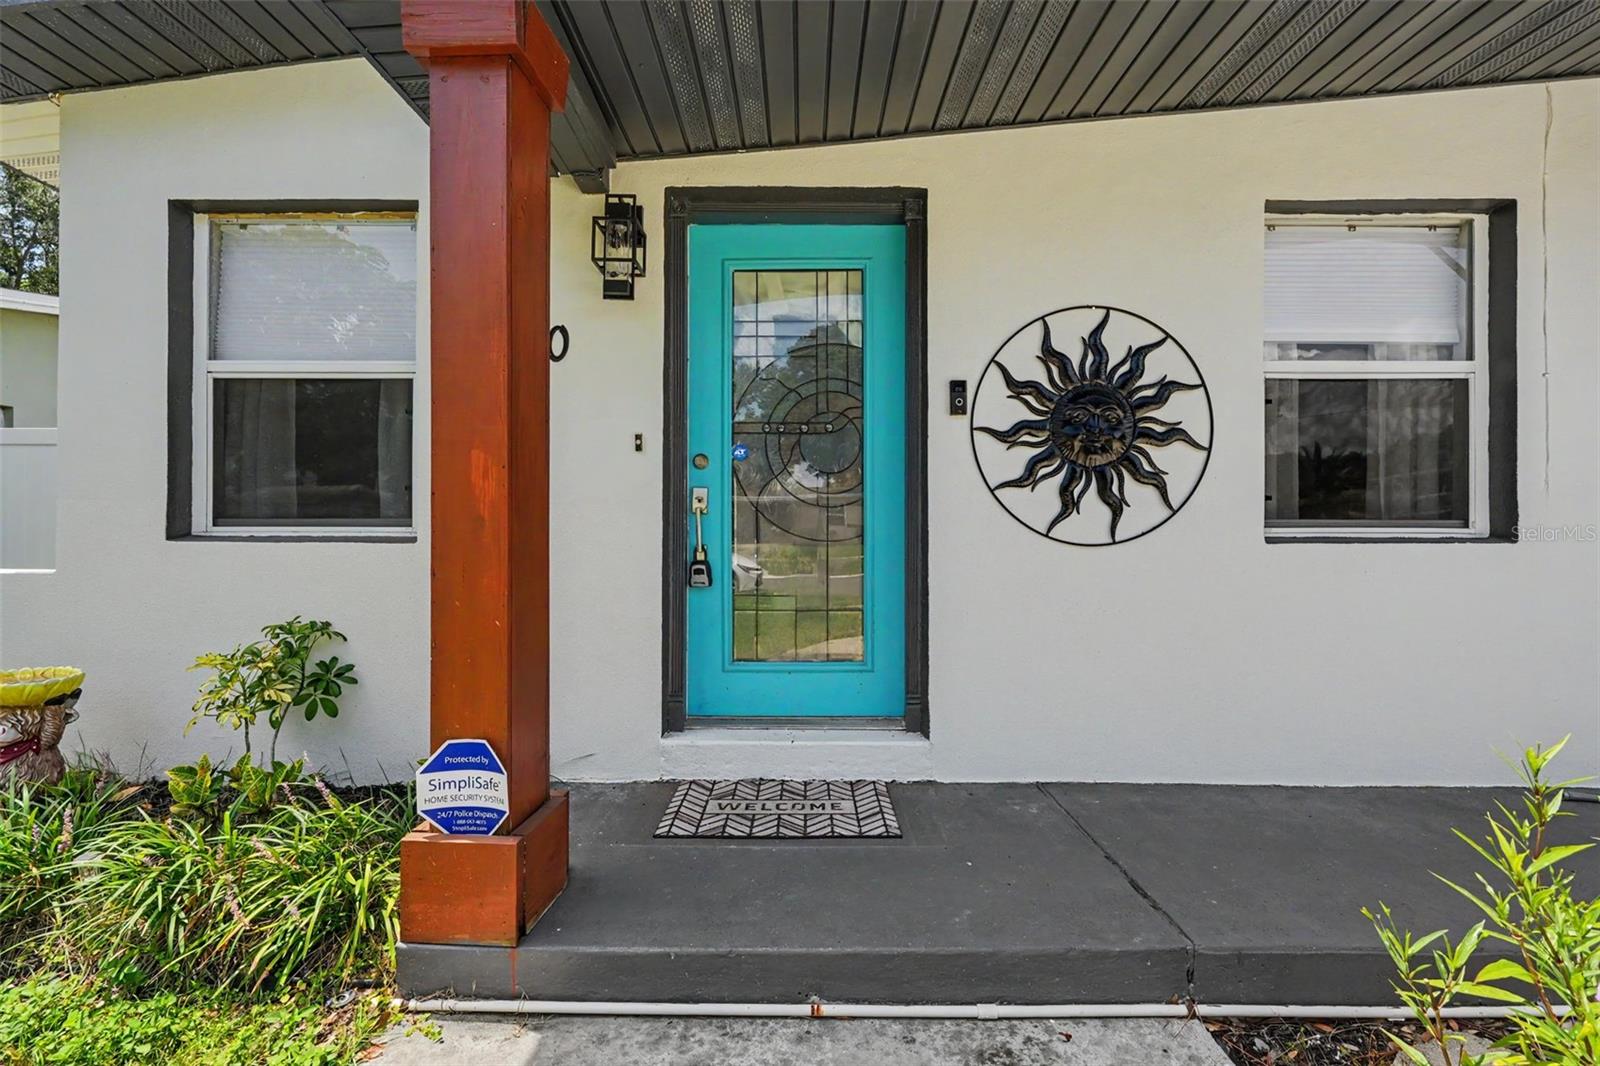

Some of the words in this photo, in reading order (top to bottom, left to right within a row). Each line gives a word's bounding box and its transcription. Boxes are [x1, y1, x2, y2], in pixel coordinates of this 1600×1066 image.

[444, 756, 480, 764] Protected
[481, 756, 489, 765] by
[428, 776, 500, 792] SimpliSafe
[424, 794, 448, 805] HOME
[449, 793, 483, 802] SECURITY
[717, 802, 844, 811] WELCOME
[437, 810, 453, 819] 24/7
[473, 810, 498, 819] Dispatch
